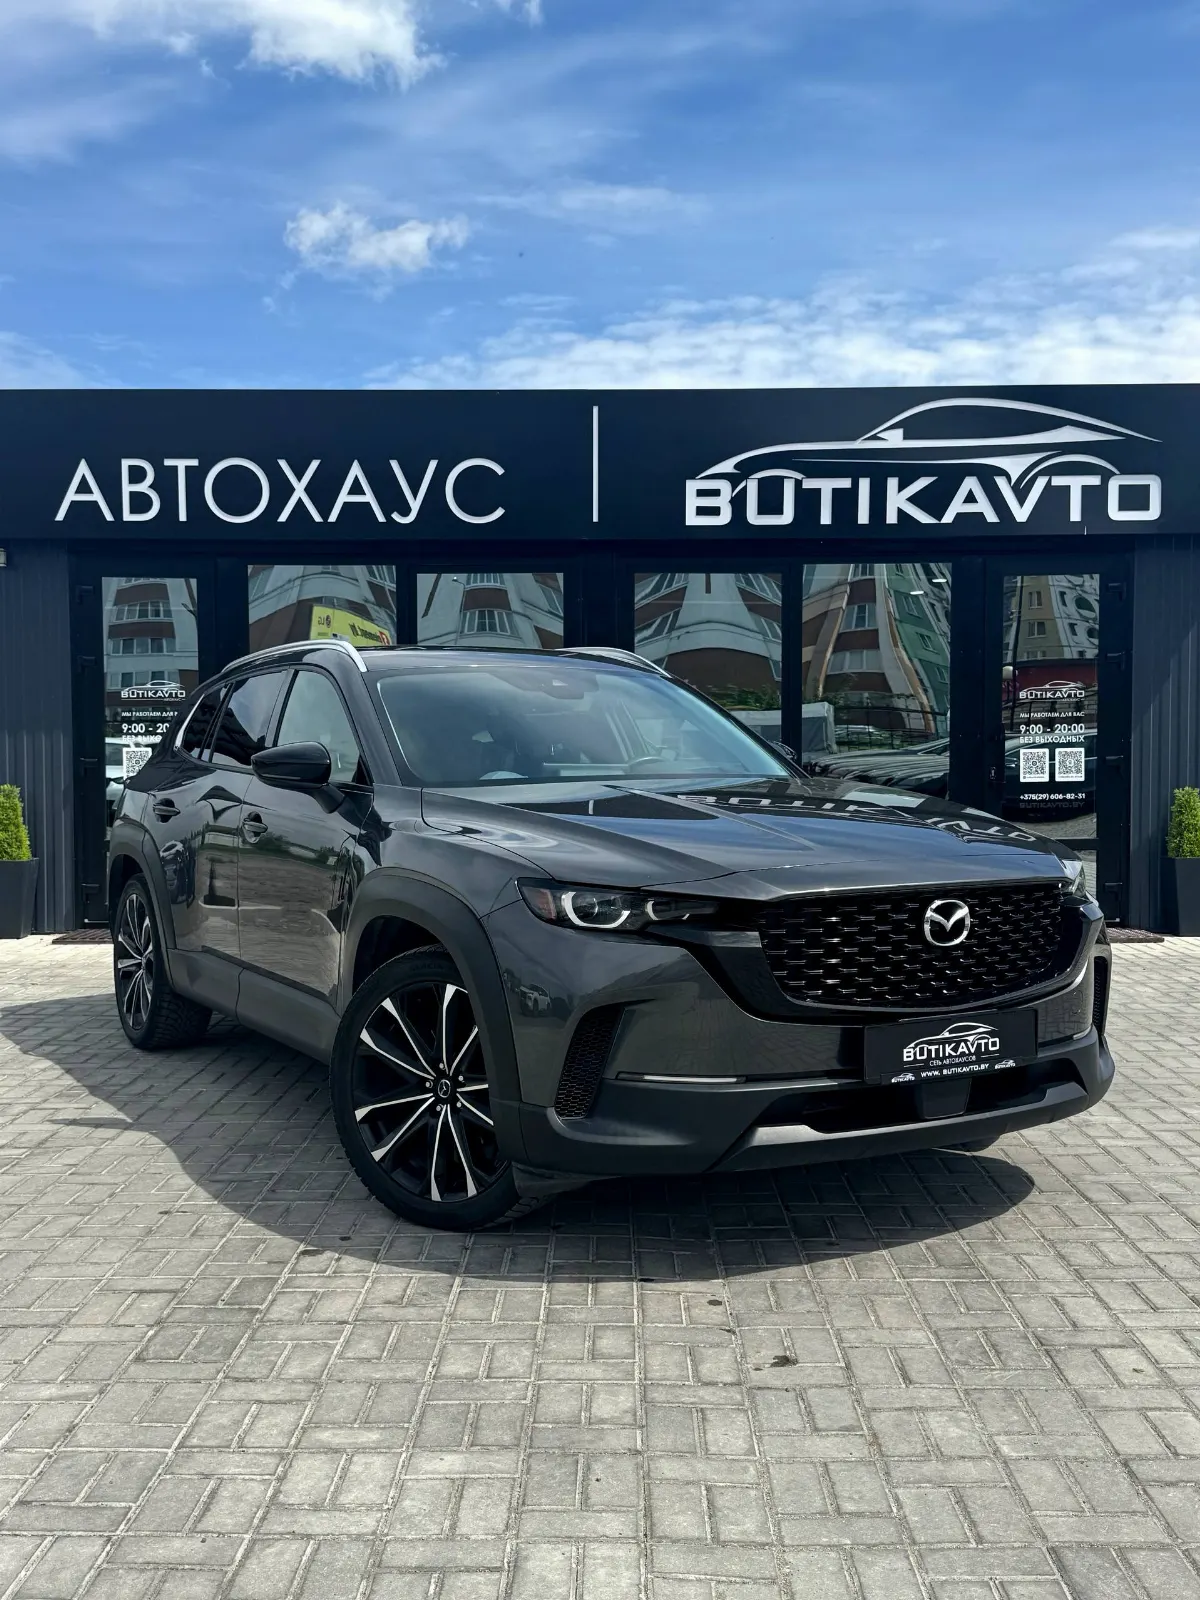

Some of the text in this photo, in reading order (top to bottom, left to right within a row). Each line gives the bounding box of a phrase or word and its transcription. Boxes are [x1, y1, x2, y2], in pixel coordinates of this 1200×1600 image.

[54, 457, 506, 524] АВТОХАУС
[684, 472, 1163, 528] BUTIKAVTO
[121, 690, 186, 698] BUTIKAVTO
[1019, 690, 1085, 698] BUTIKAVTO
[121, 723, 145, 733] 9:00
[1019, 724, 1043, 735] 9:00
[1054, 723, 1085, 734] 20:00
[1019, 735, 1085, 744] БЕЗ ВЫХОДНЫХ
[1019, 793, 1049, 801] +375(29)
[903, 1037, 1000, 1062] BUTIKAVTO
